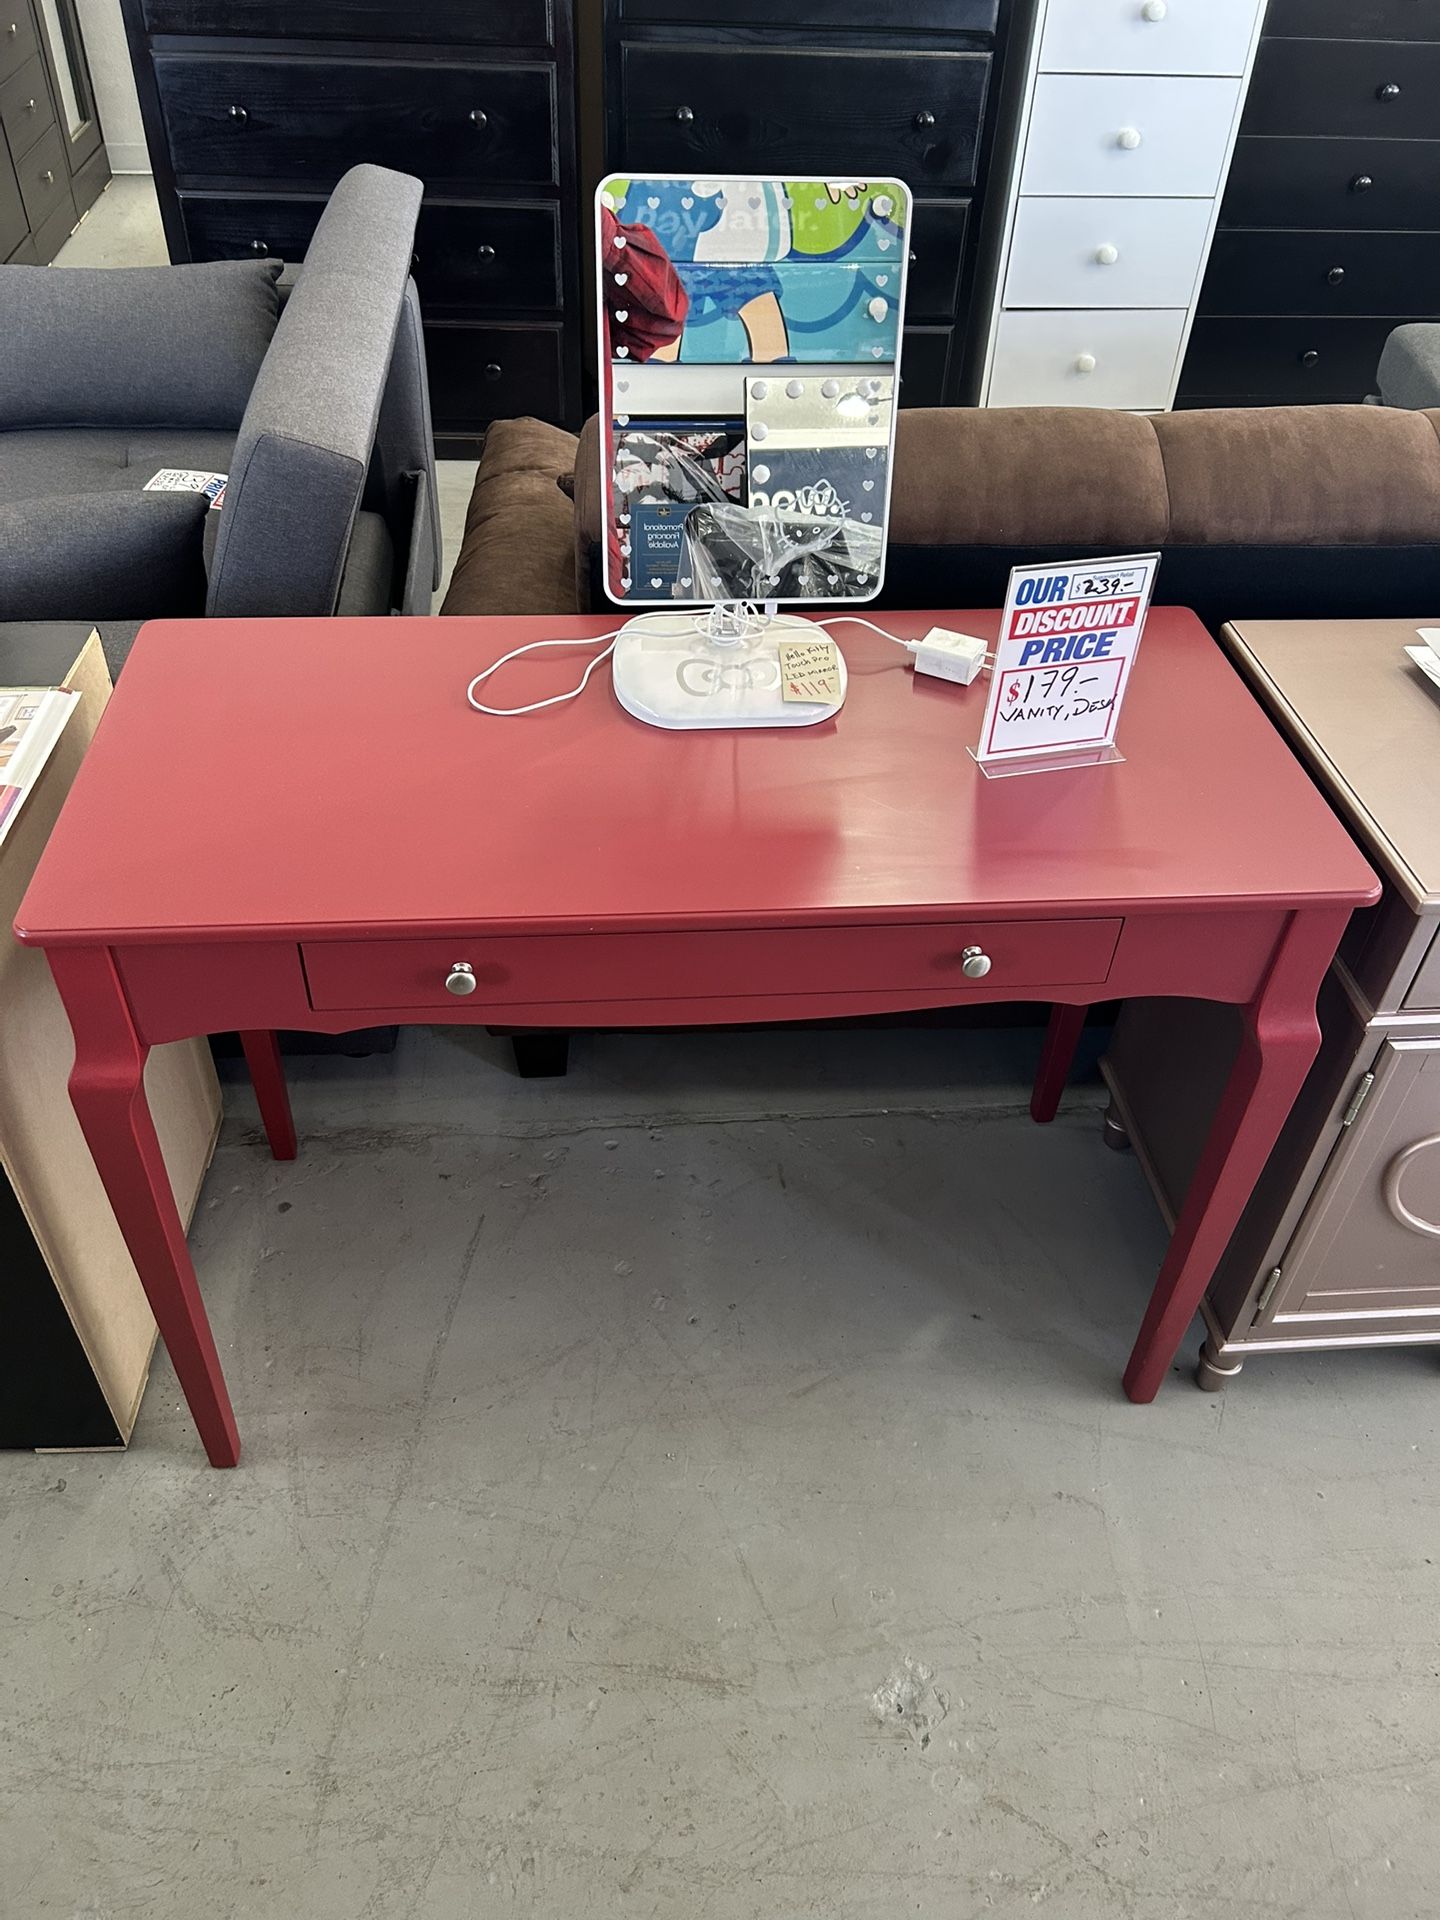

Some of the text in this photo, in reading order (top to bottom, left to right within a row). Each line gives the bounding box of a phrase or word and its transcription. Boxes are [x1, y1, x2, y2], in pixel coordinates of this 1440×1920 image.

[203, 478, 226, 501] PRIC
[1015, 575, 1069, 606] OUR
[1014, 601, 1135, 636] DISCOUNT
[1018, 631, 1118, 666] PRICE
[785, 659, 811, 670] Touch
[1000, 704, 1070, 722] VANITY,
